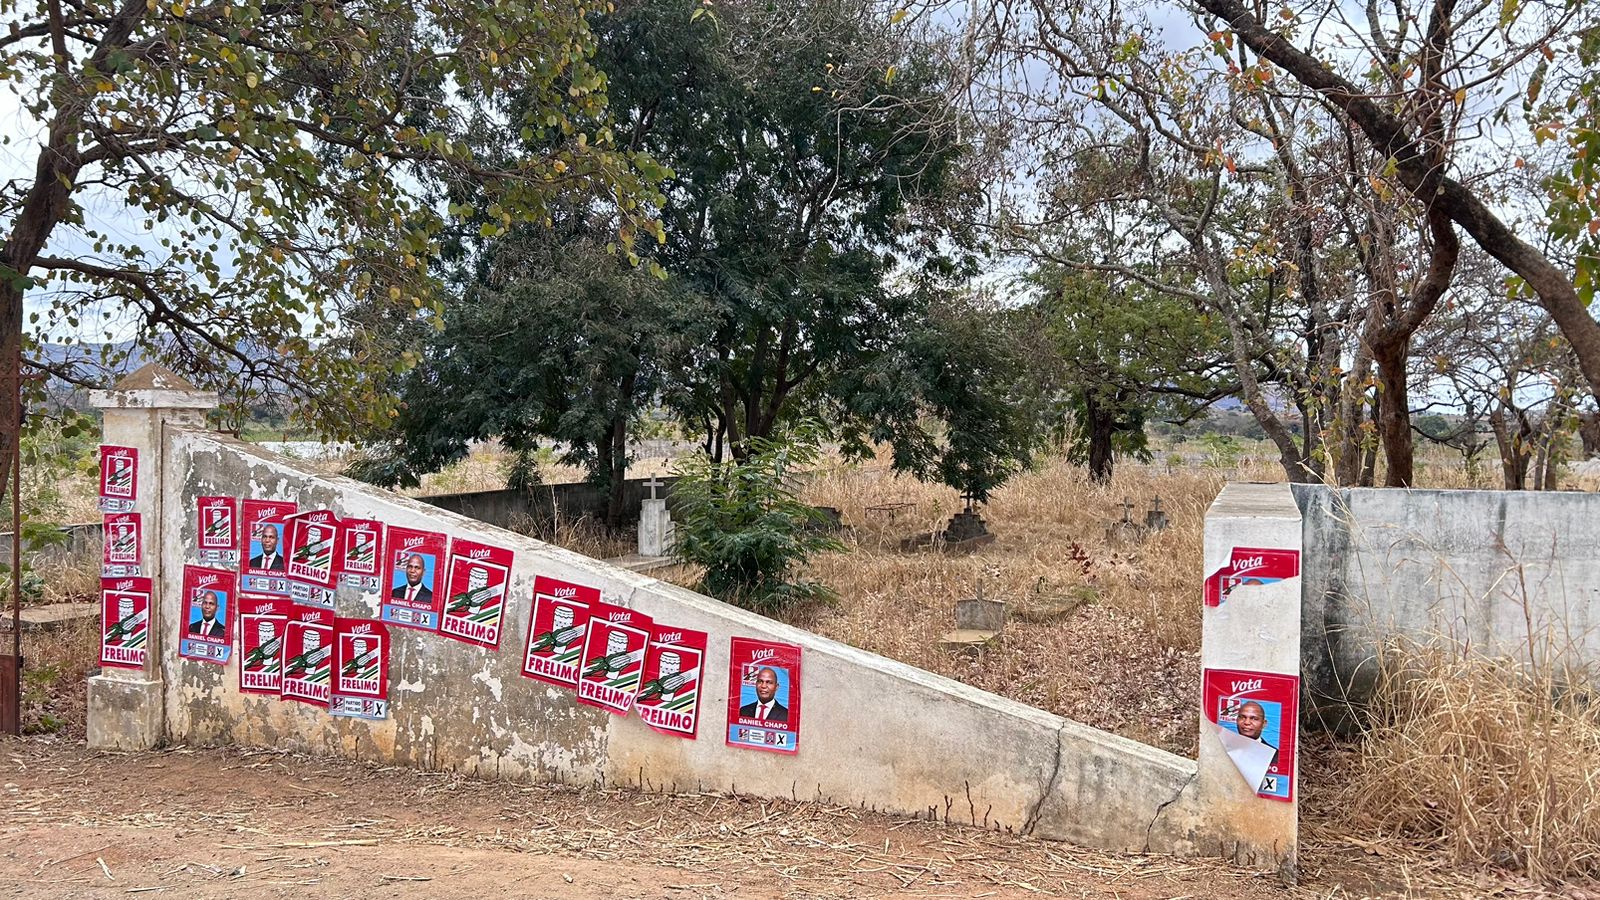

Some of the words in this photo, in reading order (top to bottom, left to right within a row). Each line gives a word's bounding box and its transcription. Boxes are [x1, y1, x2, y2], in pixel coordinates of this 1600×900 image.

[257, 507, 276, 518] Vota
[308, 513, 328, 521] Vota
[355, 523, 370, 531] Vota
[205, 537, 230, 545] FRELIMO
[403, 536, 425, 547] Vota
[469, 548, 491, 558] Vota
[346, 560, 373, 571] FRELIMO
[1232, 556, 1263, 571] Vota
[248, 568, 268, 576] DANIEL
[290, 563, 327, 580] FRELIMO
[116, 579, 134, 590] Vota
[198, 574, 217, 585] Vota
[554, 587, 577, 597] Vota
[255, 602, 274, 614] Vota
[390, 599, 410, 607] DANIEL
[411, 602, 432, 610] CHAPO
[301, 611, 321, 621] Vota
[608, 612, 632, 621] Vota
[351, 623, 371, 634] Vota
[444, 616, 496, 641] FRELIMO
[187, 633, 206, 642] DANIEL
[206, 636, 225, 644] CHAPO
[659, 631, 682, 642] Vota
[751, 648, 775, 660] Vota
[243, 673, 281, 687] FRELIM
[341, 679, 378, 692] FRELIMO
[1231, 679, 1263, 693] Vota
[580, 681, 631, 708] FRELIMO
[638, 706, 692, 729] RELIMO
[738, 717, 763, 727] DANIEL
[764, 721, 788, 730] CHAPO
